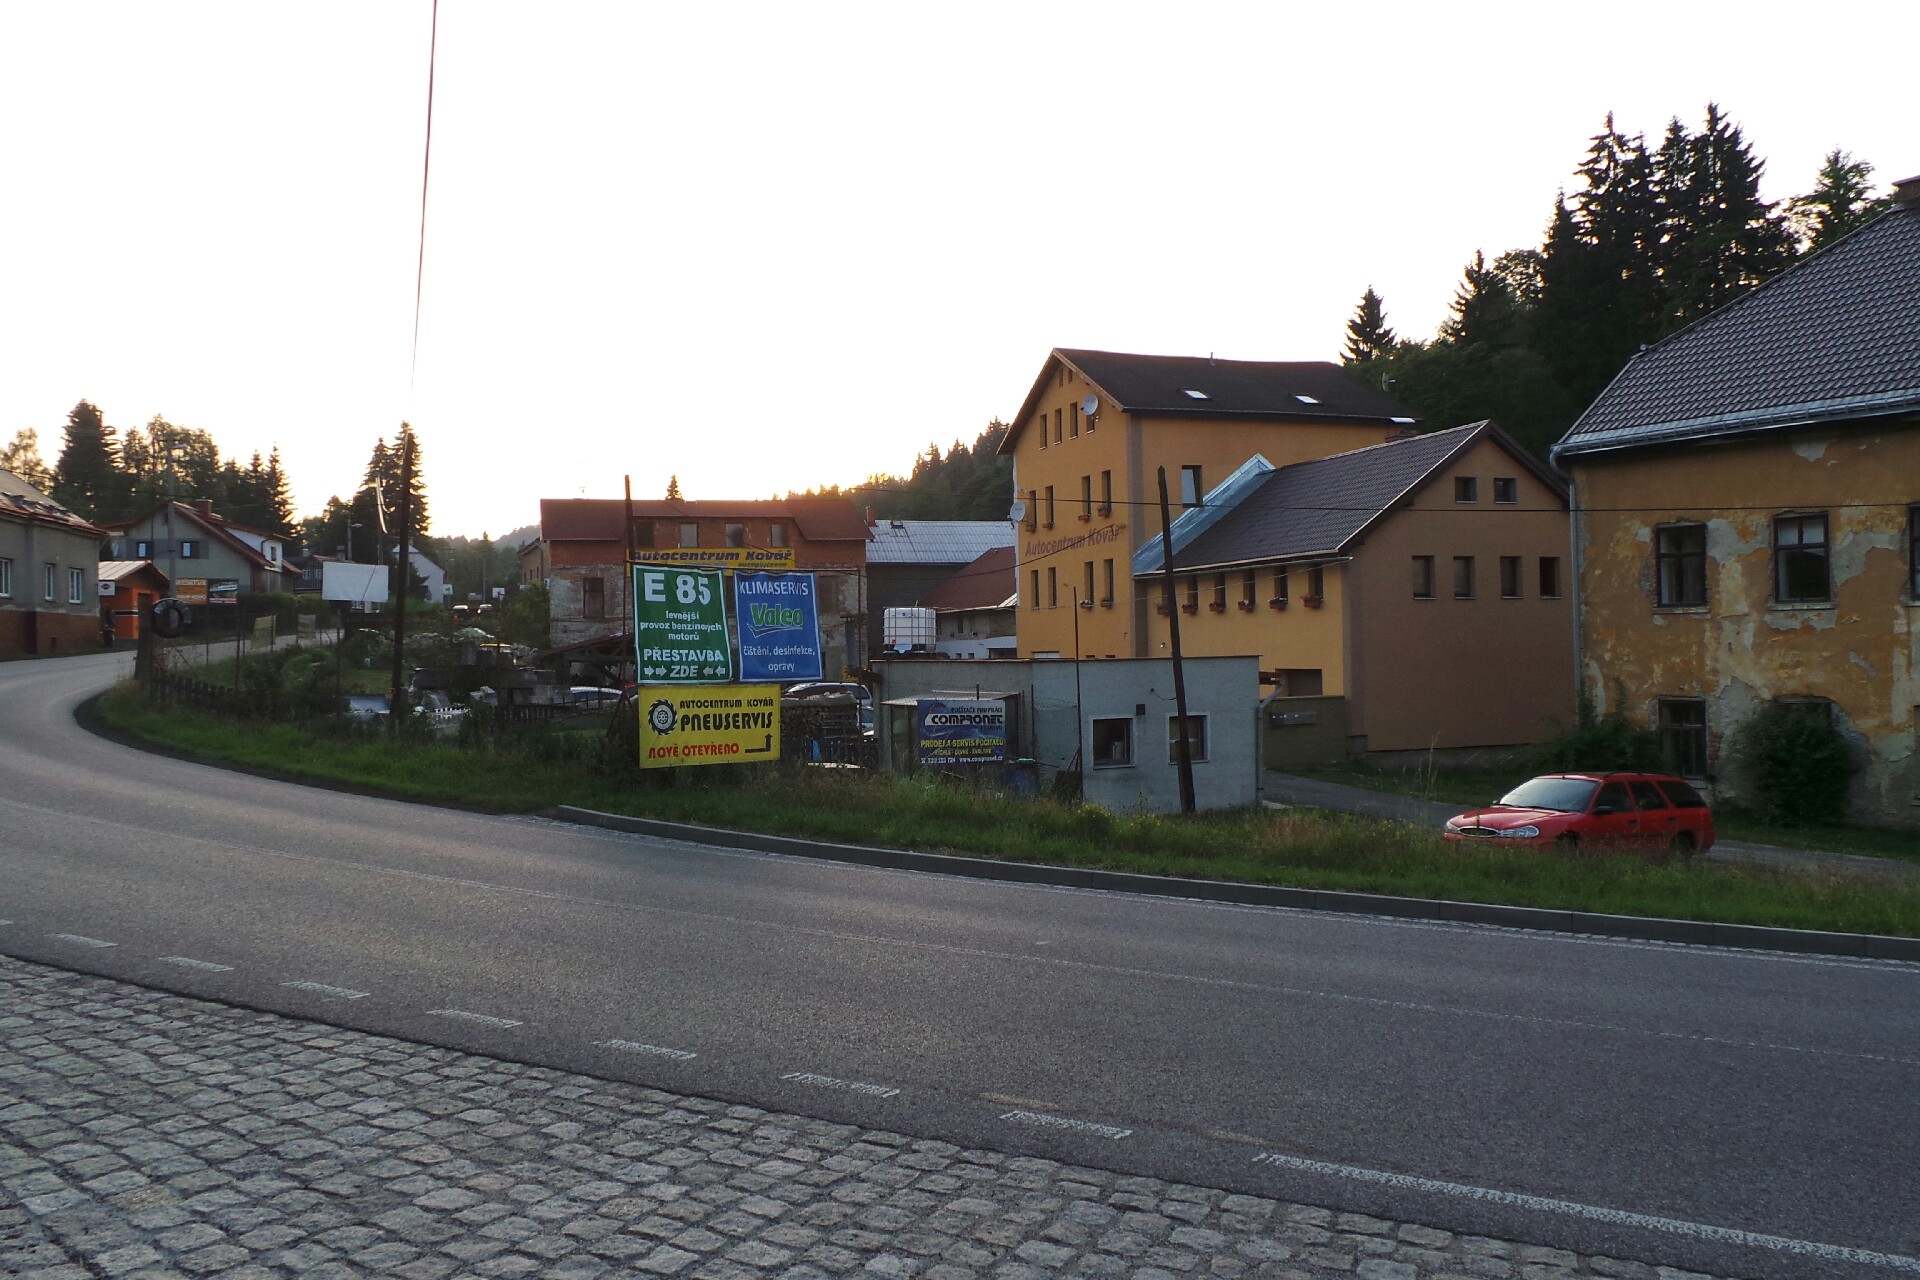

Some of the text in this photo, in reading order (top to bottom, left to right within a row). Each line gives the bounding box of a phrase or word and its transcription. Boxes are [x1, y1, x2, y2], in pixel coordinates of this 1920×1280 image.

[1025, 534, 1085, 557] Autocentrum
[634, 549, 792, 561] Autocentrum Kovář
[643, 572, 711, 605] E 85
[739, 581, 809, 596] KLIMASERVIS
[665, 610, 700, 622] levnější
[750, 603, 804, 627] Valeo
[640, 621, 670, 631] provoz
[668, 631, 700, 641] motorů
[643, 646, 725, 662] PŘESTAVBA
[743, 645, 816, 657] čištění, desinfekce,
[669, 665, 699, 678] ZDE
[768, 661, 795, 673] opravy
[680, 696, 774, 709] AUTOCENTRUM KOVÁŘ
[680, 711, 773, 732] PNEUSERVIS
[931, 714, 1003, 725] COMPRONET
[953, 738, 975, 747] SERVIS
[681, 741, 740, 758] OTEVŘENO
